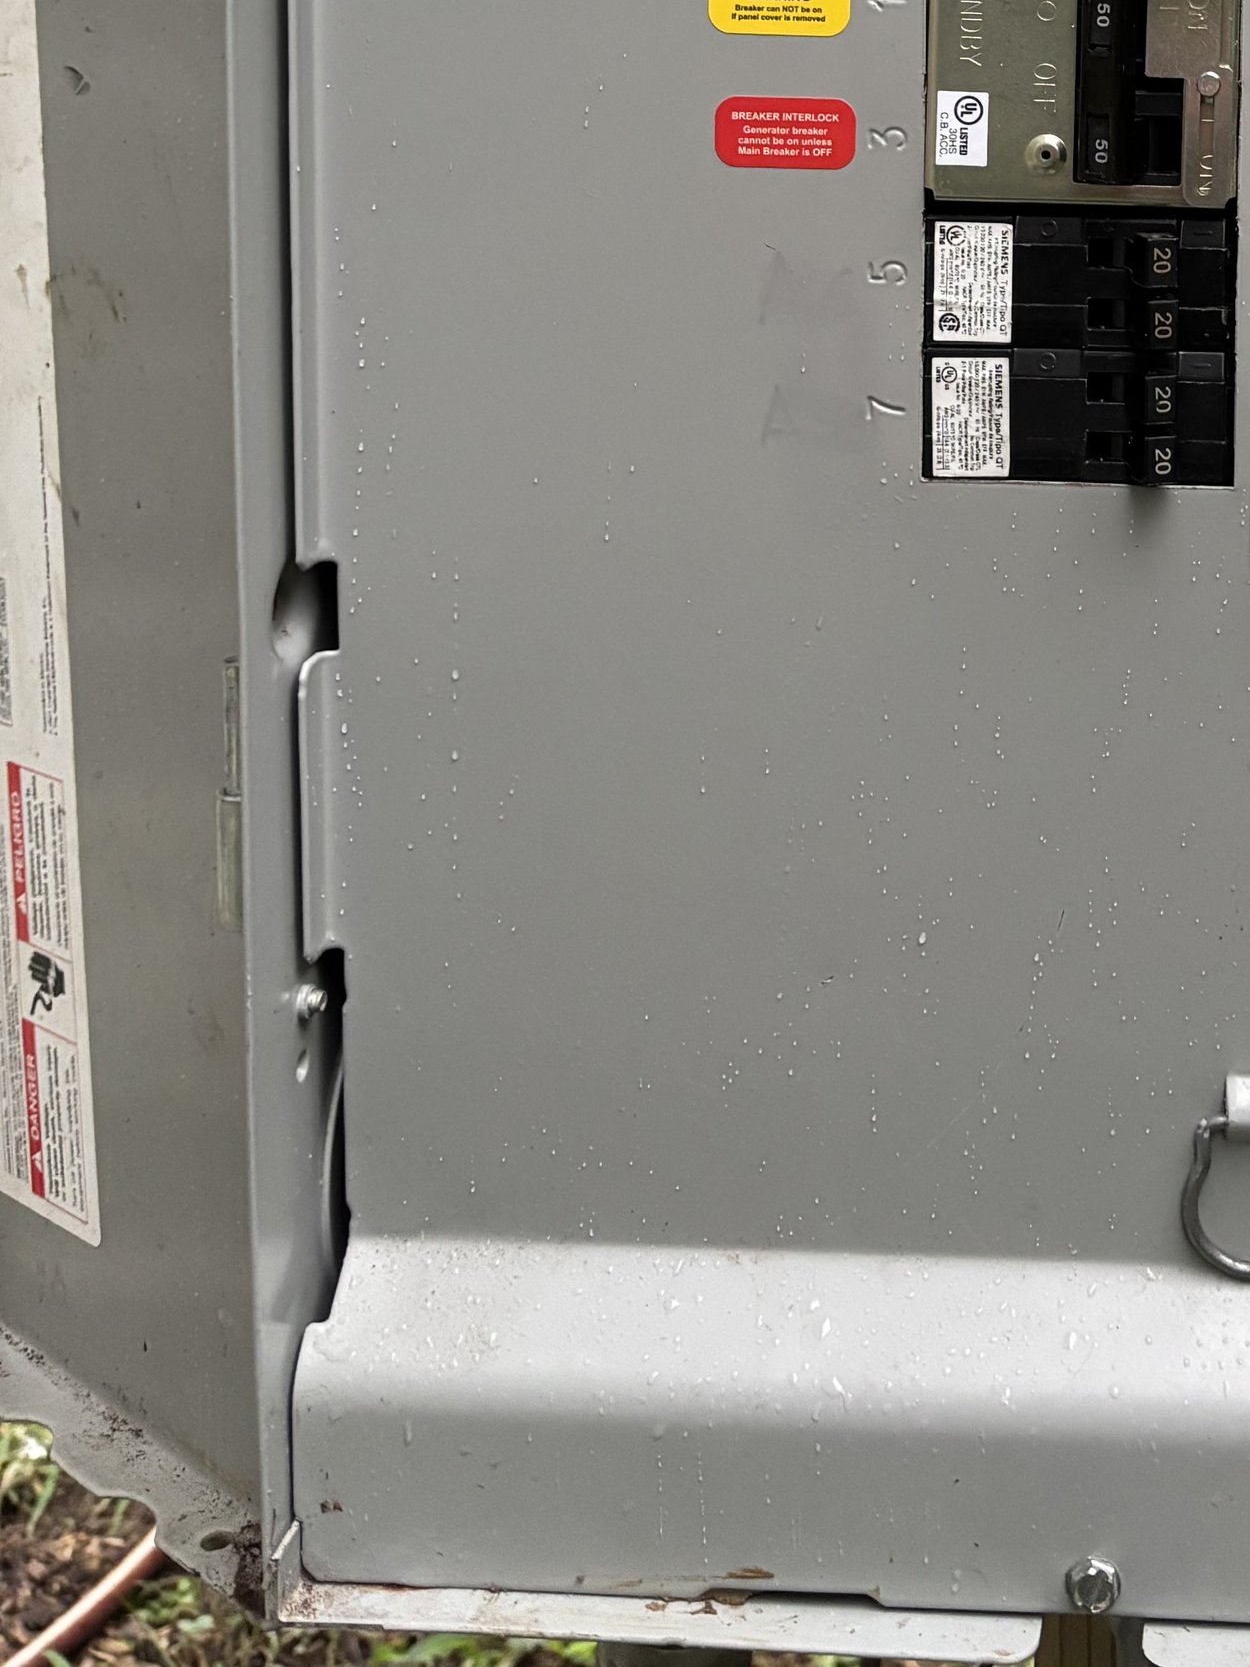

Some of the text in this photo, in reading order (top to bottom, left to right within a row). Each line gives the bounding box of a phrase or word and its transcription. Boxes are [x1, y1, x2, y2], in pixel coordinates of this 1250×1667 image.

[737, 13, 759, 21] panel
[1097, 2, 1111, 27] 50
[1033, 62, 1058, 113] OFF
[731, 111, 839, 122] BREAKER INTERLOCK
[737, 136, 770, 144] cannot
[772, 136, 784, 145] be
[801, 137, 832, 146] unless
[742, 125, 828, 135] Generator breaker
[868, 126, 907, 151] 3
[949, 128, 957, 154] 30HS
[959, 127, 968, 155] LISTED
[737, 146, 832, 156] Main Breaker is OFF
[1095, 138, 1109, 164] 50
[1000, 230, 1009, 275] SIEMENS
[1152, 247, 1171, 274] 20
[867, 260, 908, 287] 5
[1155, 312, 1173, 339] 20
[994, 364, 1003, 409] SIEMENS
[866, 395, 907, 421] 7
[1155, 387, 1171, 413] 20
[1155, 449, 1171, 475] 20
[25, 1053, 38, 1141] DANGER
